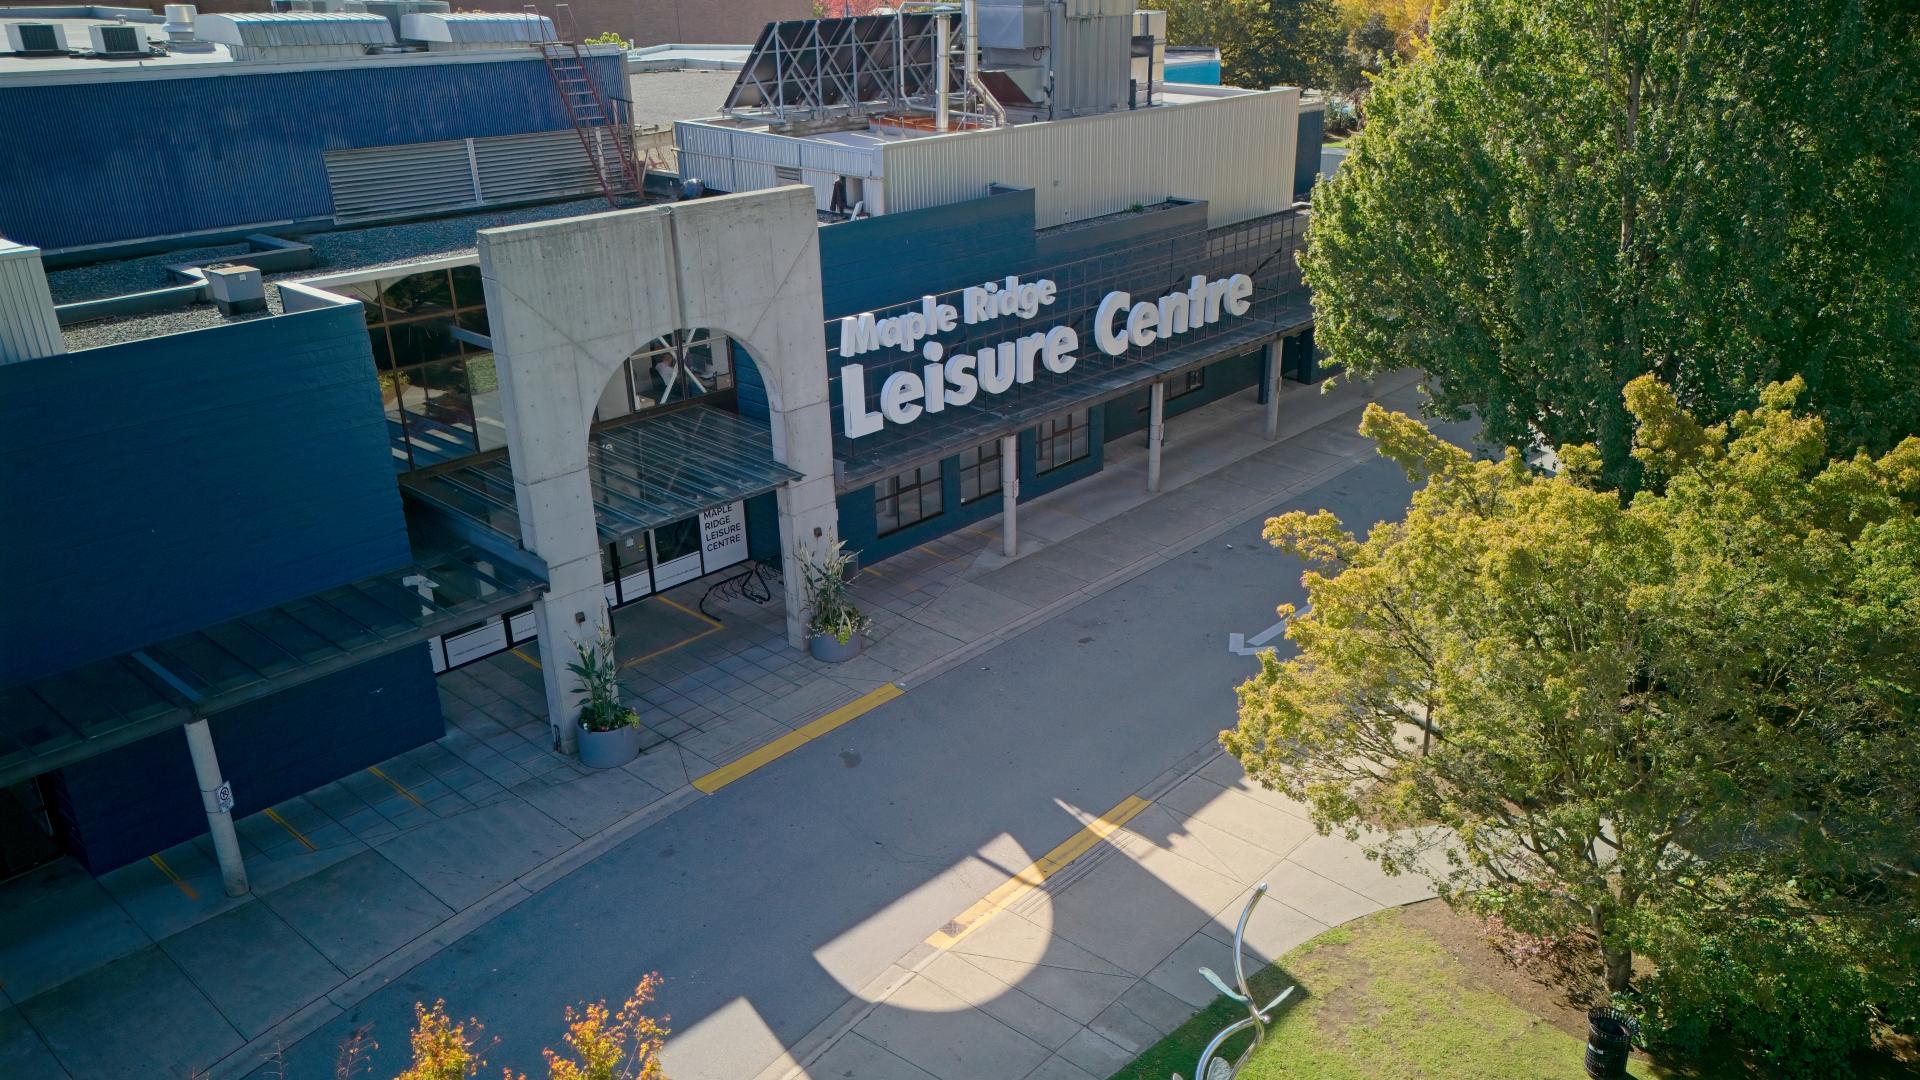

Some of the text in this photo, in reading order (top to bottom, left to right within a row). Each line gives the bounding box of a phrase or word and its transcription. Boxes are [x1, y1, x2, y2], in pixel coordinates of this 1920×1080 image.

[840, 276, 1057, 357] Maple Ridge
[841, 273, 1253, 439] Leisure Centre
[703, 503, 733, 520] MAPLE
[704, 515, 731, 531] RIDGE
[705, 522, 741, 542] LEISURE
[706, 533, 741, 552] CENTRE
